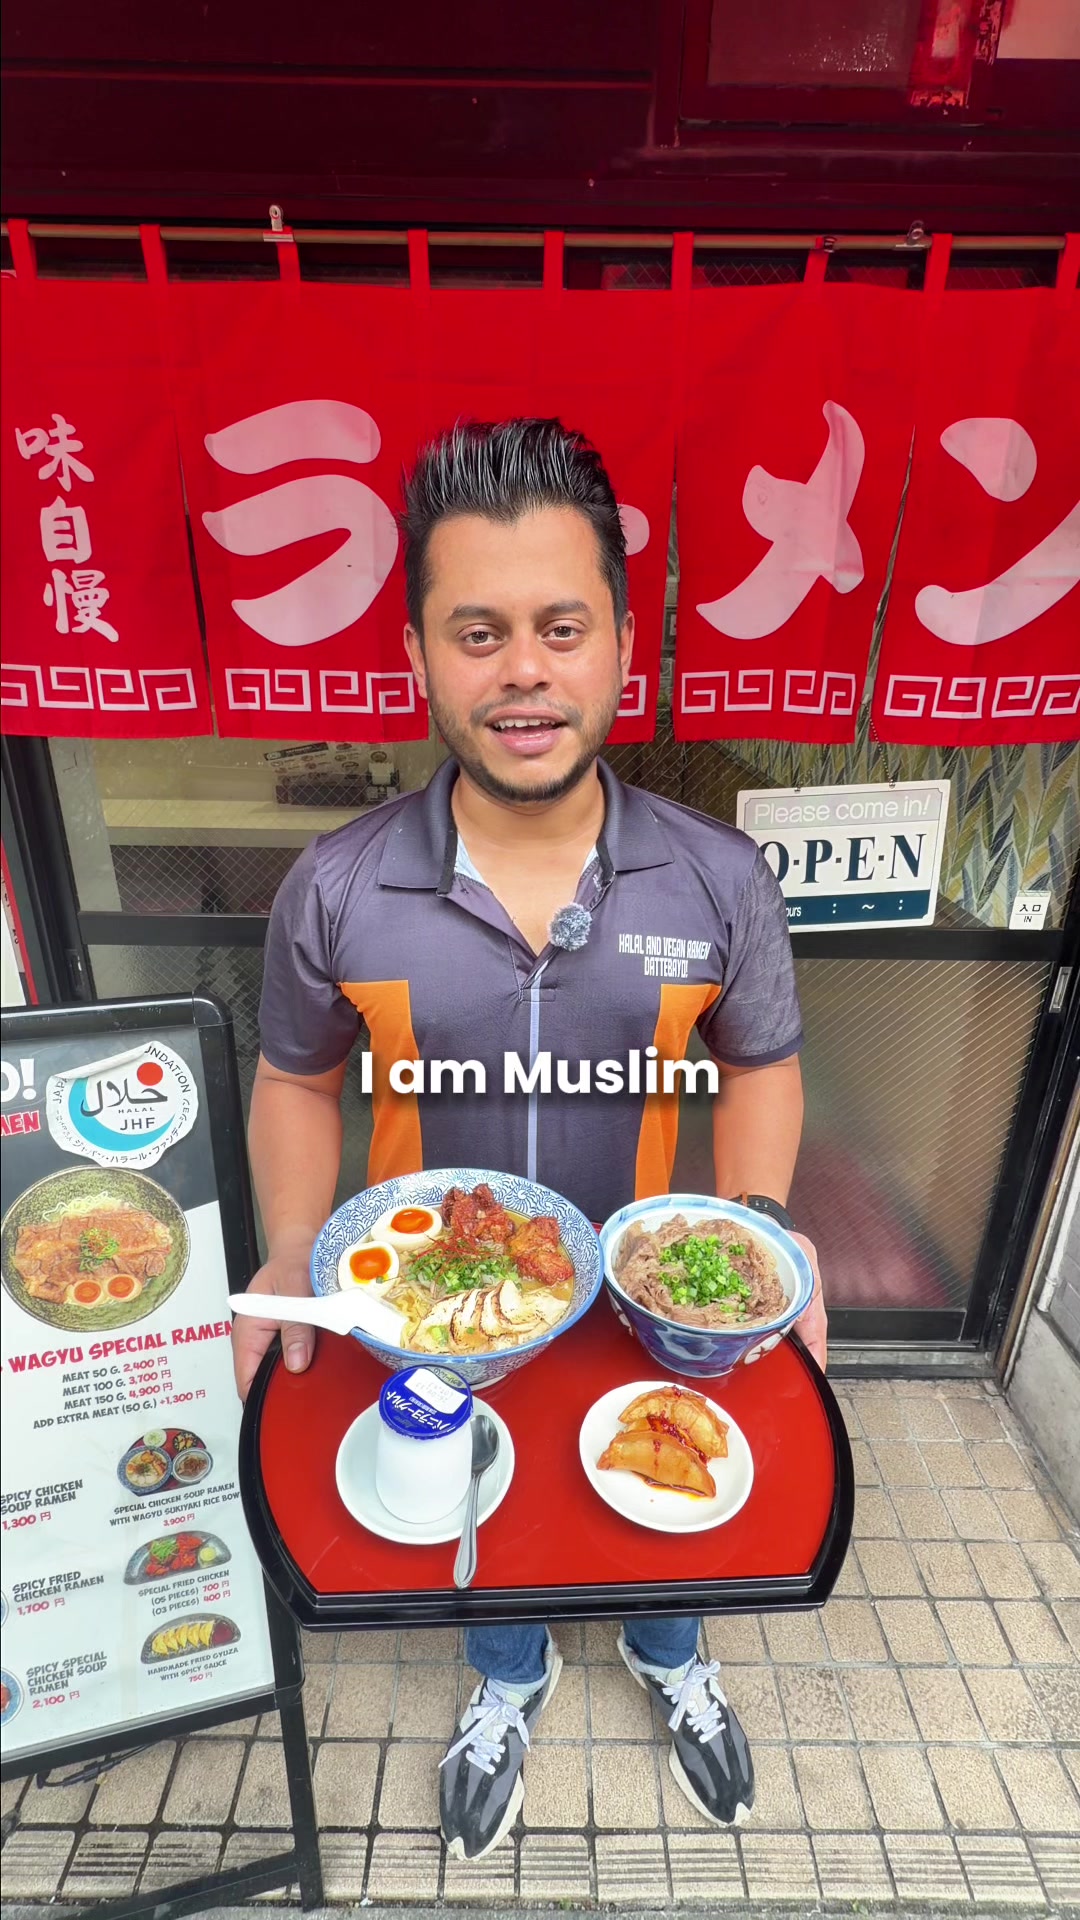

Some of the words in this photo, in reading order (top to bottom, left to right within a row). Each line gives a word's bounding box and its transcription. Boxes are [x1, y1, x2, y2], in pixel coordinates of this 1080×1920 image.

[15, 413, 119, 643] 味自慢
[202, 399, 1080, 645] ラメン
[754, 803, 831, 825] Please
[835, 800, 899, 820] come
[903, 795, 931, 816] in!
[786, 905, 802, 918] ours
[1019, 903, 1042, 913] 入口
[1023, 915, 1033, 923] IN
[619, 933, 644, 954] HALAL
[646, 936, 661, 956] AND
[663, 937, 686, 958] VEGAN
[687, 940, 711, 960] RAMEN
[80, 1078, 168, 1118] حلال
[120, 1117, 156, 1131] JHF
[8, 1346, 84, 1373] WAGYU
[88, 1333, 167, 1360] SPECIAL
[62, 1371, 90, 1383] MEAT
[93, 1368, 107, 1378] 50
[110, 1365, 120, 1376] G.
[123, 1359, 155, 1373] 2,400
[157, 1356, 168, 1367] 円
[62, 1384, 91, 1397] MEAT
[93, 1381, 113, 1392] 100
[115, 1378, 126, 1388] G.
[129, 1372, 158, 1385] 3,700
[161, 1369, 172, 1380] 円
[64, 1397, 93, 1410] MEAT
[95, 1394, 114, 1405] 150
[116, 1391, 127, 1401] G.
[129, 1385, 161, 1399] 4,900
[163, 1382, 173, 1392] 円
[33, 1417, 54, 1430] ADD
[57, 1412, 90, 1425] EXTRA
[92, 1406, 120, 1419] MEAT
[122, 1402, 141, 1415] (50
[142, 1398, 157, 1410] G.)
[159, 1392, 193, 1406] +1,300
[195, 1389, 206, 1399] 円
[386, 1391, 451, 1431] バニラヨーグルト
[35, 1479, 83, 1497] CHICKEN
[114, 1502, 146, 1515] SPECIAL
[148, 1495, 181, 1508] CHICKEN
[183, 1489, 205, 1500] SOUP
[207, 1482, 235, 1494] RAMEN
[1, 1500, 32, 1515] SOUP
[35, 1491, 76, 1507] RAMEN
[109, 1516, 130, 1526] WITH
[132, 1510, 162, 1522] WAGYU
[164, 1502, 201, 1515] SUKIYAKI
[203, 1496, 220, 1507] RICE
[222, 1491, 240, 1502] BOW
[2, 1514, 37, 1530] 1,300
[40, 1511, 51, 1521] 円
[163, 1516, 185, 1526] 3,900
[12, 1578, 46, 1594] SPICY
[49, 1571, 81, 1586] FRIED
[13, 1585, 61, 1603] CHICKEN
[64, 1575, 105, 1591] RAMEN
[138, 1585, 171, 1597] SPECIAL
[172, 1578, 195, 1589] FRIED
[197, 1569, 230, 1583] CHICKEN
[168, 1587, 199, 1601] PIECES)
[202, 1583, 220, 1592] 700
[17, 1600, 50, 1616] 1,700
[54, 1597, 65, 1608] 円
[152, 1605, 167, 1616] (03
[169, 1597, 200, 1612] PIECES)
[26, 1661, 59, 1678] SPICY
[62, 1651, 107, 1669] SPECIAL
[27, 1668, 74, 1687] CHICKEN
[76, 1661, 108, 1676] SOUP
[147, 1661, 189, 1676] HANDMADE
[190, 1655, 211, 1666] FRIED
[160, 1671, 179, 1681] WITH
[180, 1665, 202, 1677] SPICY
[204, 1660, 227, 1670] SAUCE
[29, 1679, 69, 1696] RAMEN
[32, 1694, 66, 1709] 2,100
[69, 1690, 80, 1700] 円
